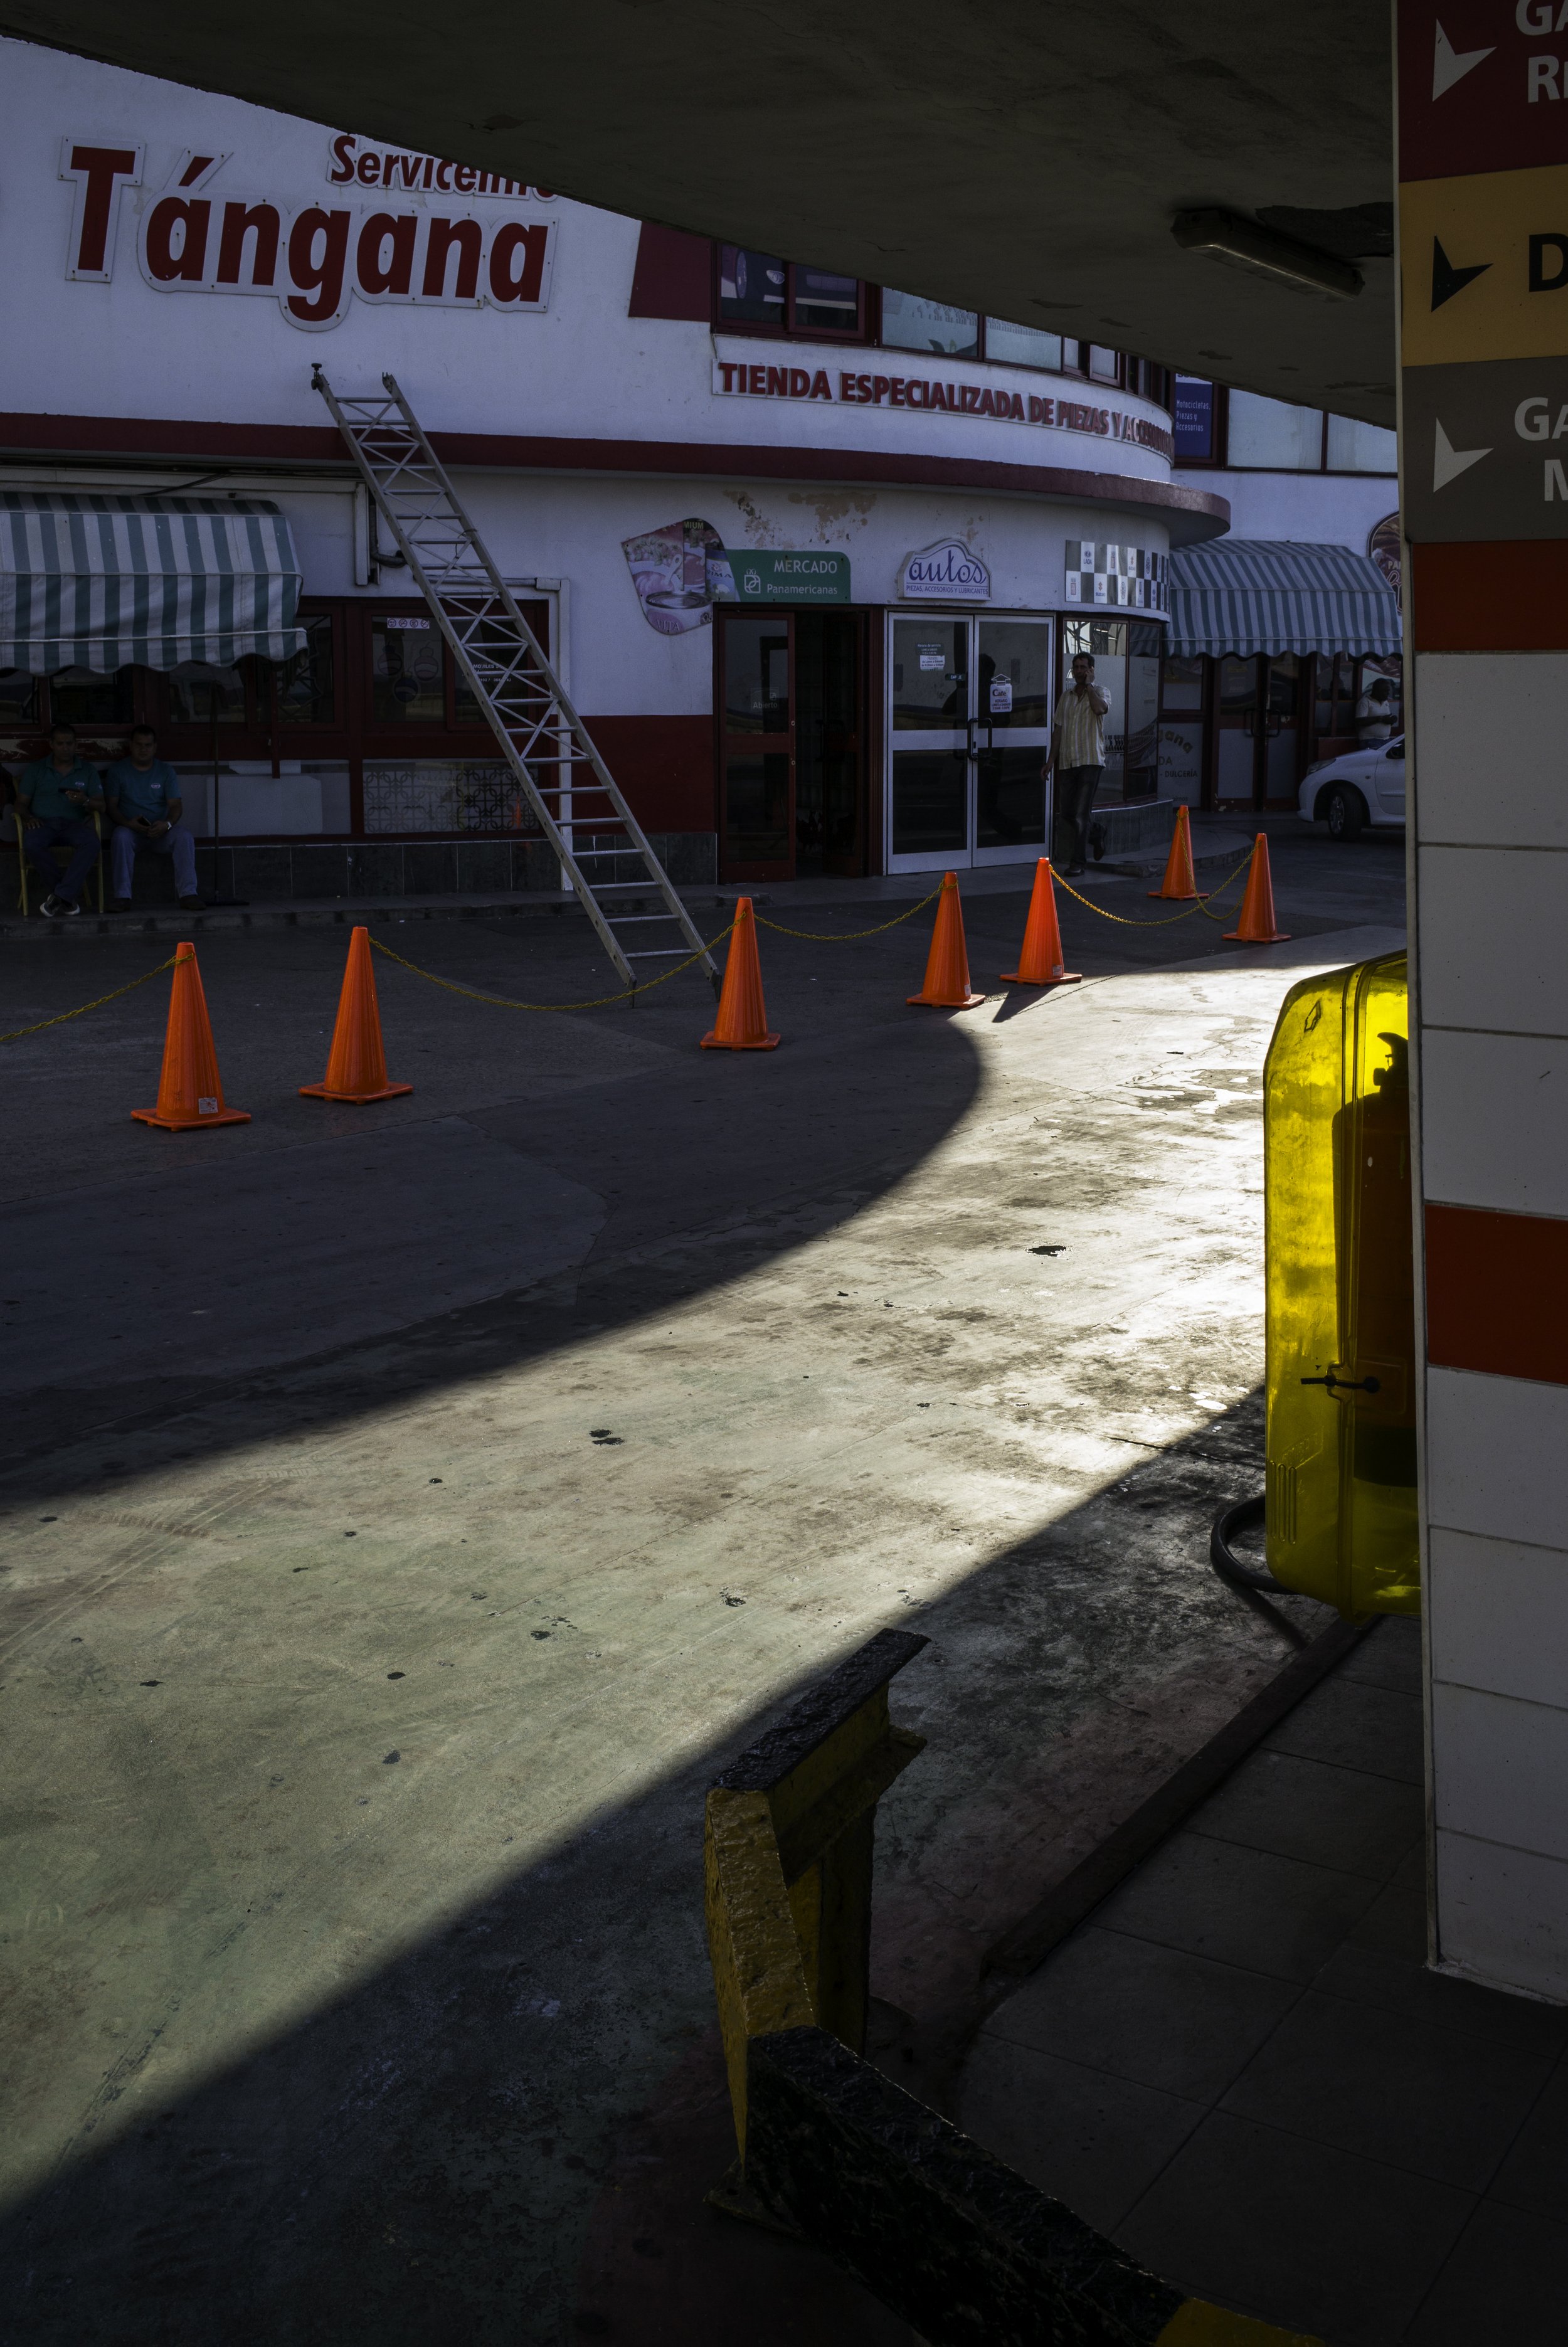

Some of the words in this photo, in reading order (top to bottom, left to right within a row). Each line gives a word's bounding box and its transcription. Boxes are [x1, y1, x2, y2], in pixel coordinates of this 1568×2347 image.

[1527, 55, 1568, 103] R
[331, 134, 556, 199] Servicen
[71, 146, 548, 322] Tángana
[718, 362, 832, 400] TIENDA
[840, 372, 1025, 421] ESPECIALIZADA
[1029, 396, 1054, 425] DE
[1057, 400, 1110, 435] PIEZAS
[1111, 411, 1121, 438] Y
[1176, 400, 1211, 411] Motocicletas,
[1176, 410, 1193, 420] Piezas
[1194, 413, 1198, 422] y
[1176, 421, 1204, 432] Accesorios
[773, 559, 838, 574] MERCADO
[909, 550, 987, 584] autos
[1387, 560, 1402, 570] PA
[766, 584, 838, 595] Panamericanas
[906, 585, 924, 593] PIEZAS,
[657, 618, 680, 632] VITA
[992, 689, 1007, 697] Café
[1165, 769, 1198, 778] DULCERÍA
